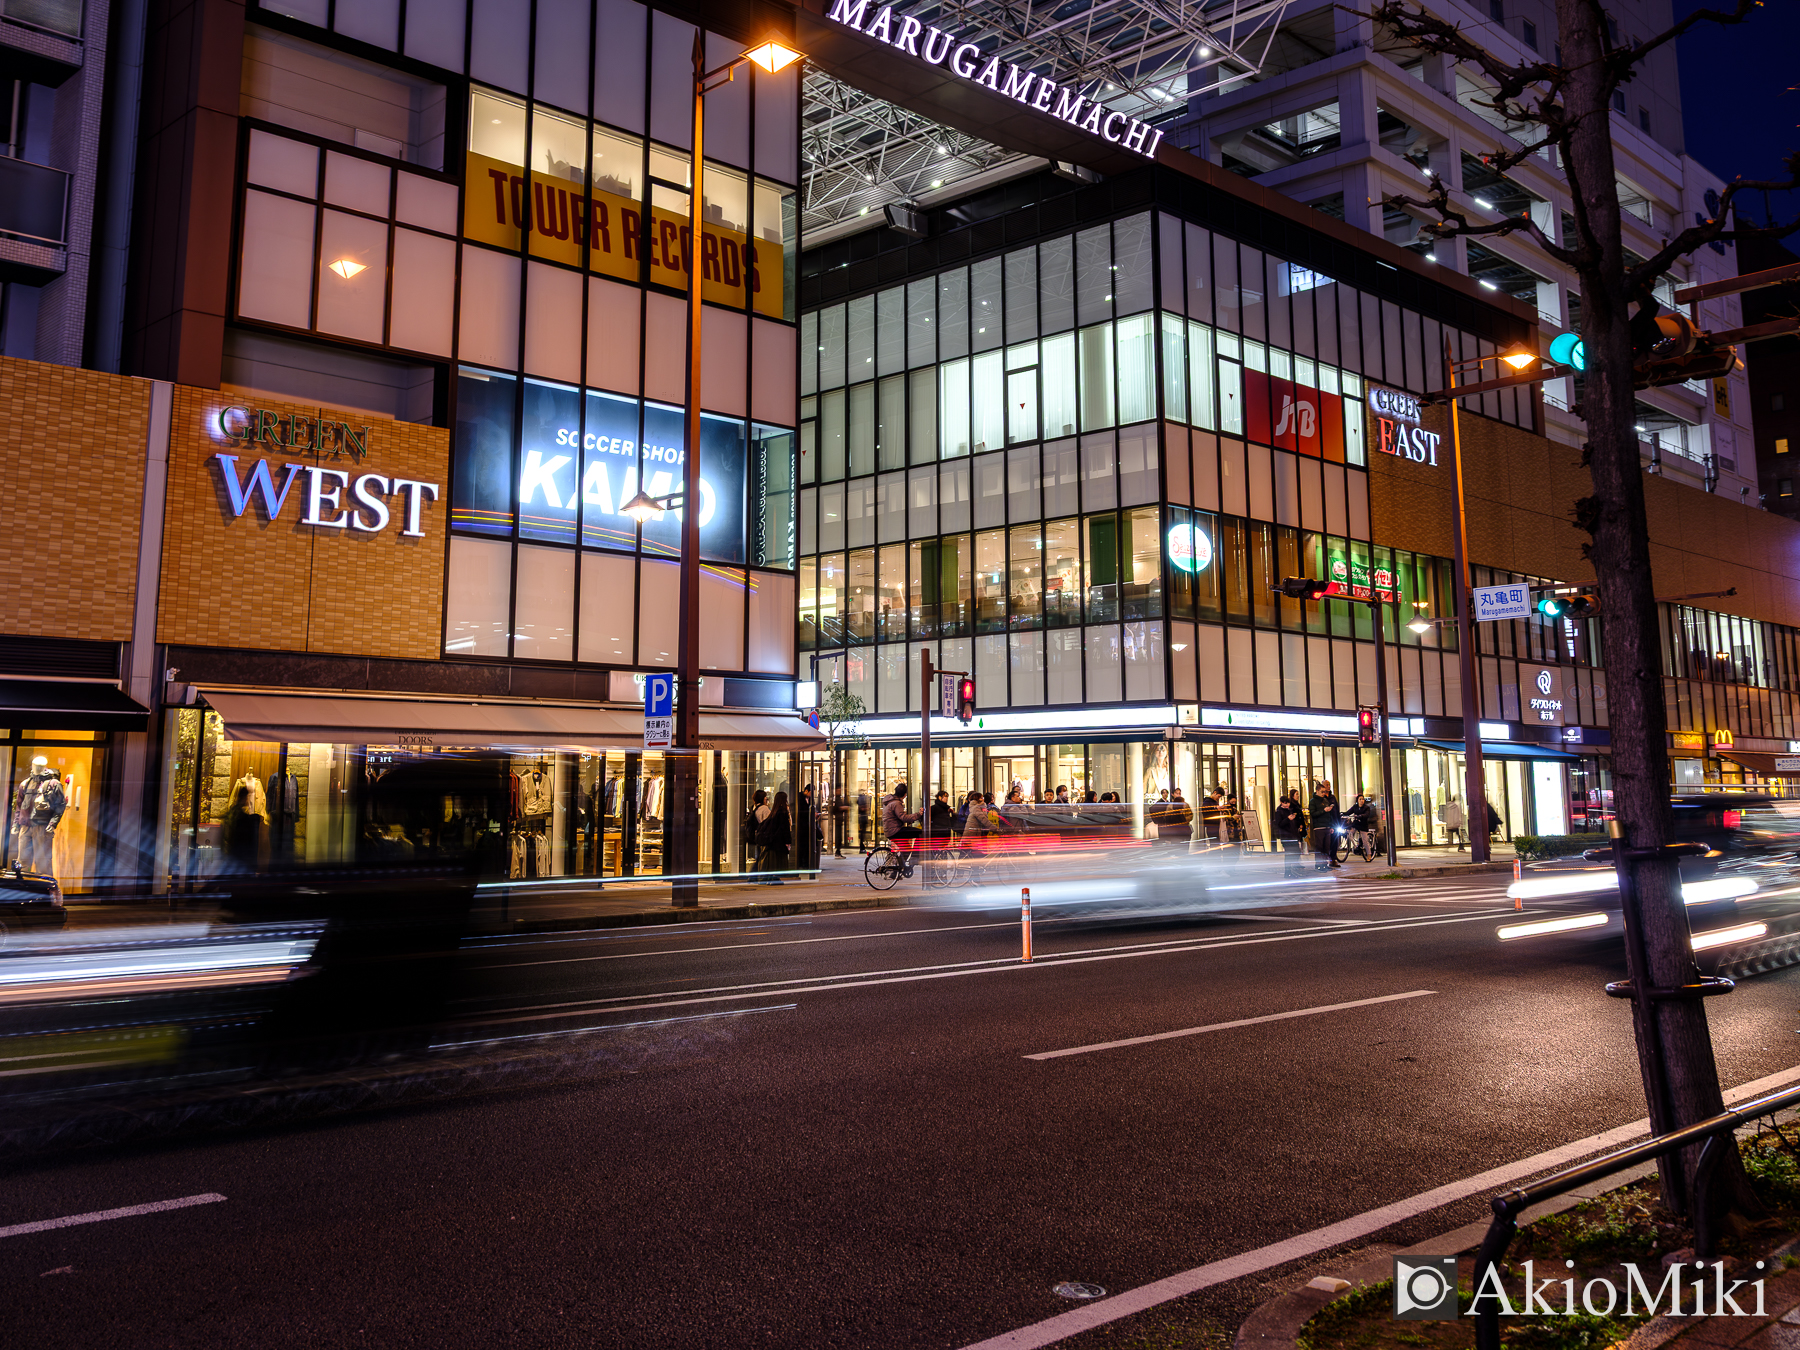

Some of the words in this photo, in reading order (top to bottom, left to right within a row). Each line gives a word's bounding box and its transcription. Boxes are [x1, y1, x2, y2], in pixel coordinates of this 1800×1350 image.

[828, 0, 1165, 159] MARUGAMEMACHI
[488, 167, 611, 254] TOWER
[1275, 394, 1316, 438] JTB
[1376, 389, 1422, 420] GREEN
[218, 405, 373, 458] GREEN
[556, 428, 634, 457] SOCCER
[1379, 417, 1440, 467] EAST
[215, 452, 439, 537] WEST
[519, 450, 716, 528] KAMO
[1480, 589, 1523, 607] 丸亀町
[1481, 605, 1525, 617] Marugamemachi
[651, 678, 668, 713] P
[398, 735, 433, 744] DOORS
